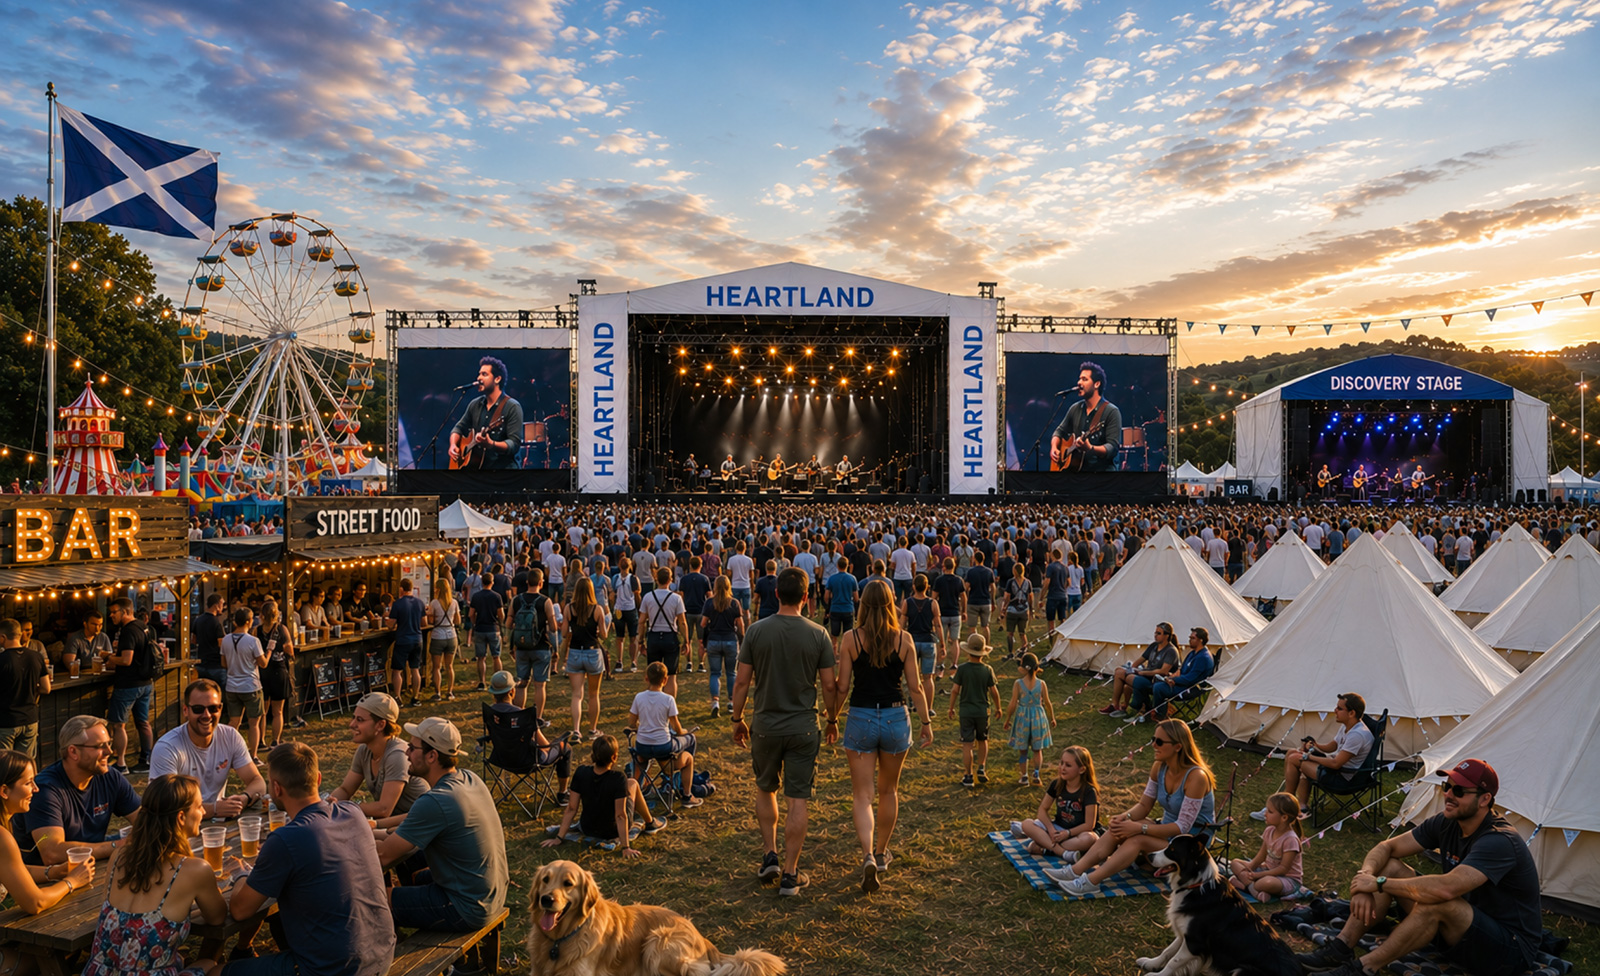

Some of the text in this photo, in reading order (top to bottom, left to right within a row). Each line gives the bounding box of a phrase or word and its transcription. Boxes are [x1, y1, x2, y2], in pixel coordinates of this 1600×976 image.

[706, 285, 875, 308] HEARTLAND
[1330, 375, 1463, 391] DISCOVERY STAGE
[593, 322, 614, 477] HEARTLAND
[963, 325, 984, 478] HEARTLAND
[1229, 485, 1249, 495] BAR
[15, 507, 142, 563] BAR
[316, 507, 421, 536] STREET FOOD
